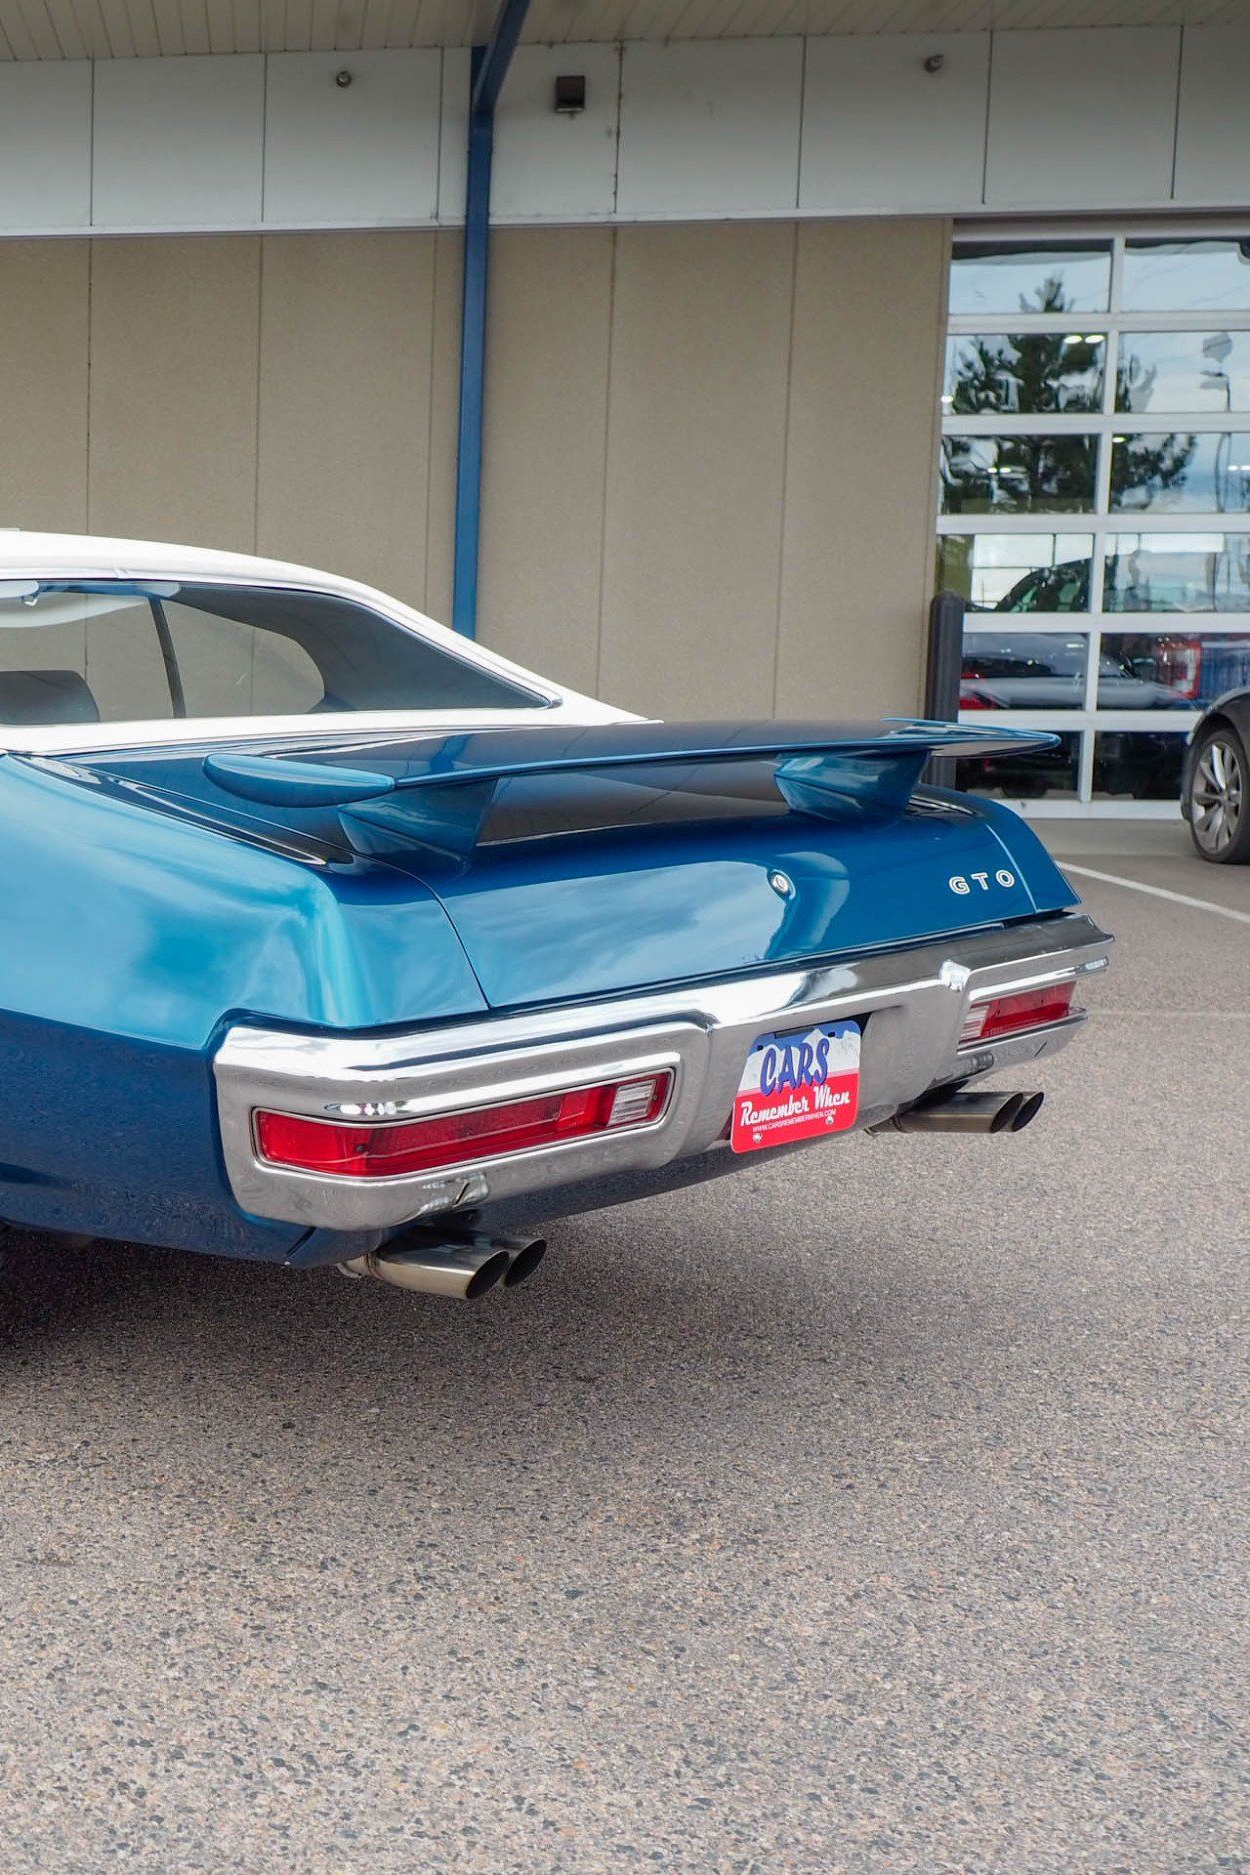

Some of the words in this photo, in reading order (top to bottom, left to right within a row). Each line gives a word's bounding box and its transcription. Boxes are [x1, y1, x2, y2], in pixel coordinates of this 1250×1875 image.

[948, 869, 1016, 895] GTO
[760, 1038, 830, 1096] CARS
[740, 1095, 810, 1127] Remember
[813, 1084, 851, 1110] When
